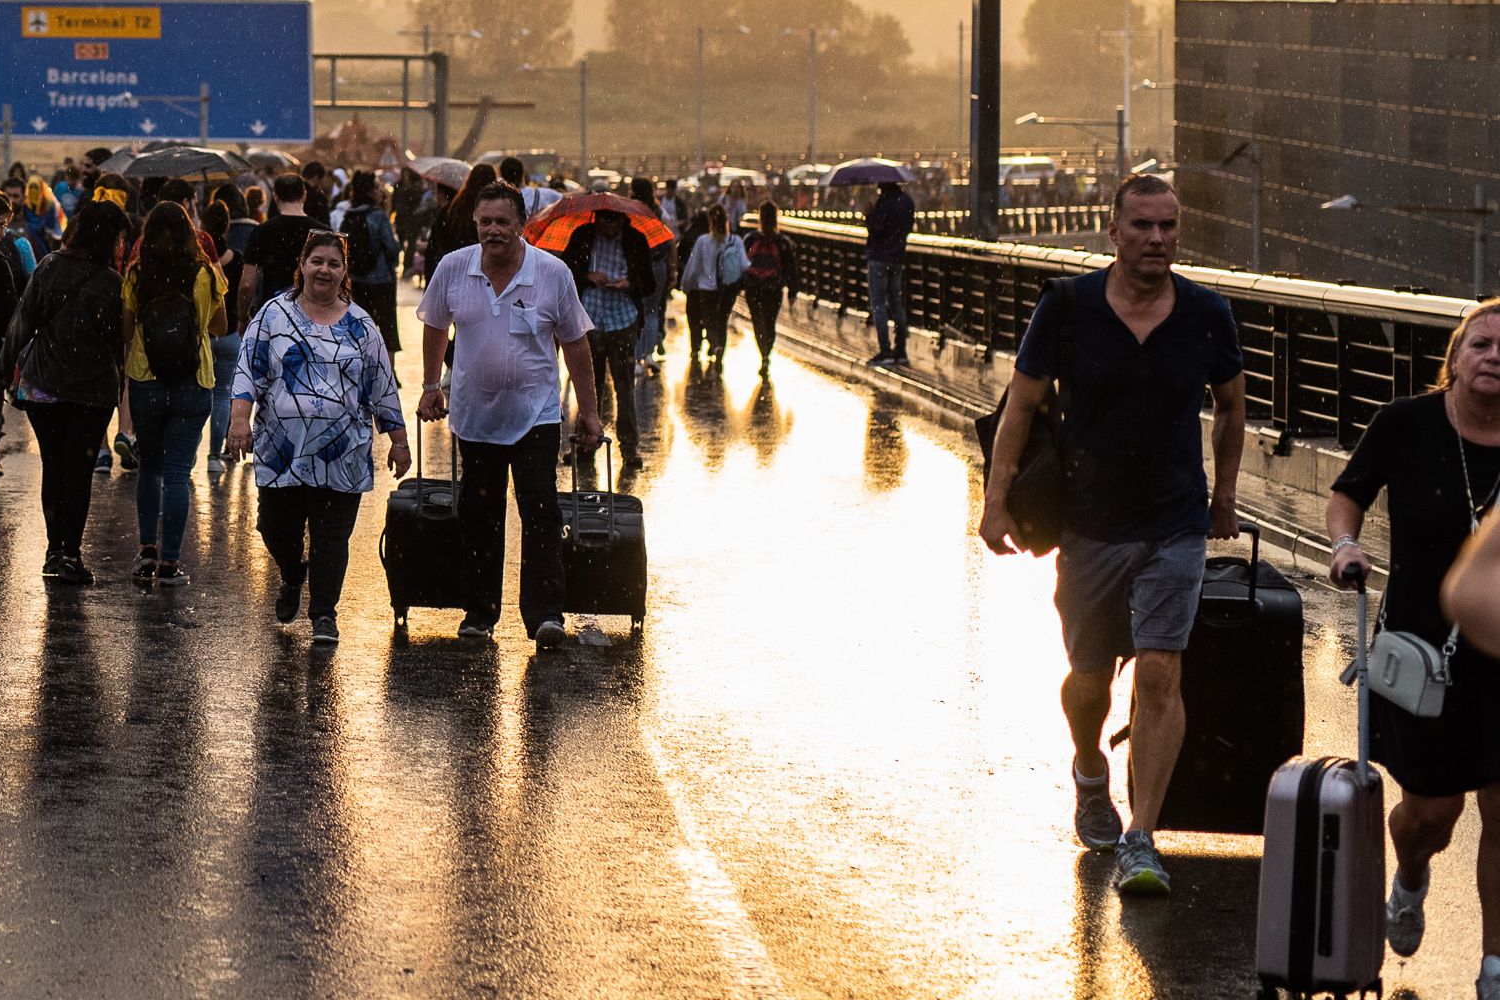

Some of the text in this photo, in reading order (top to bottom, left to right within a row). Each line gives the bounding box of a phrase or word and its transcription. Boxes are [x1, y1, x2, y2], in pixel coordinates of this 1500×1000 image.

[57, 15, 151, 28] Terminal T2
[47, 68, 138, 85] Barcelona
